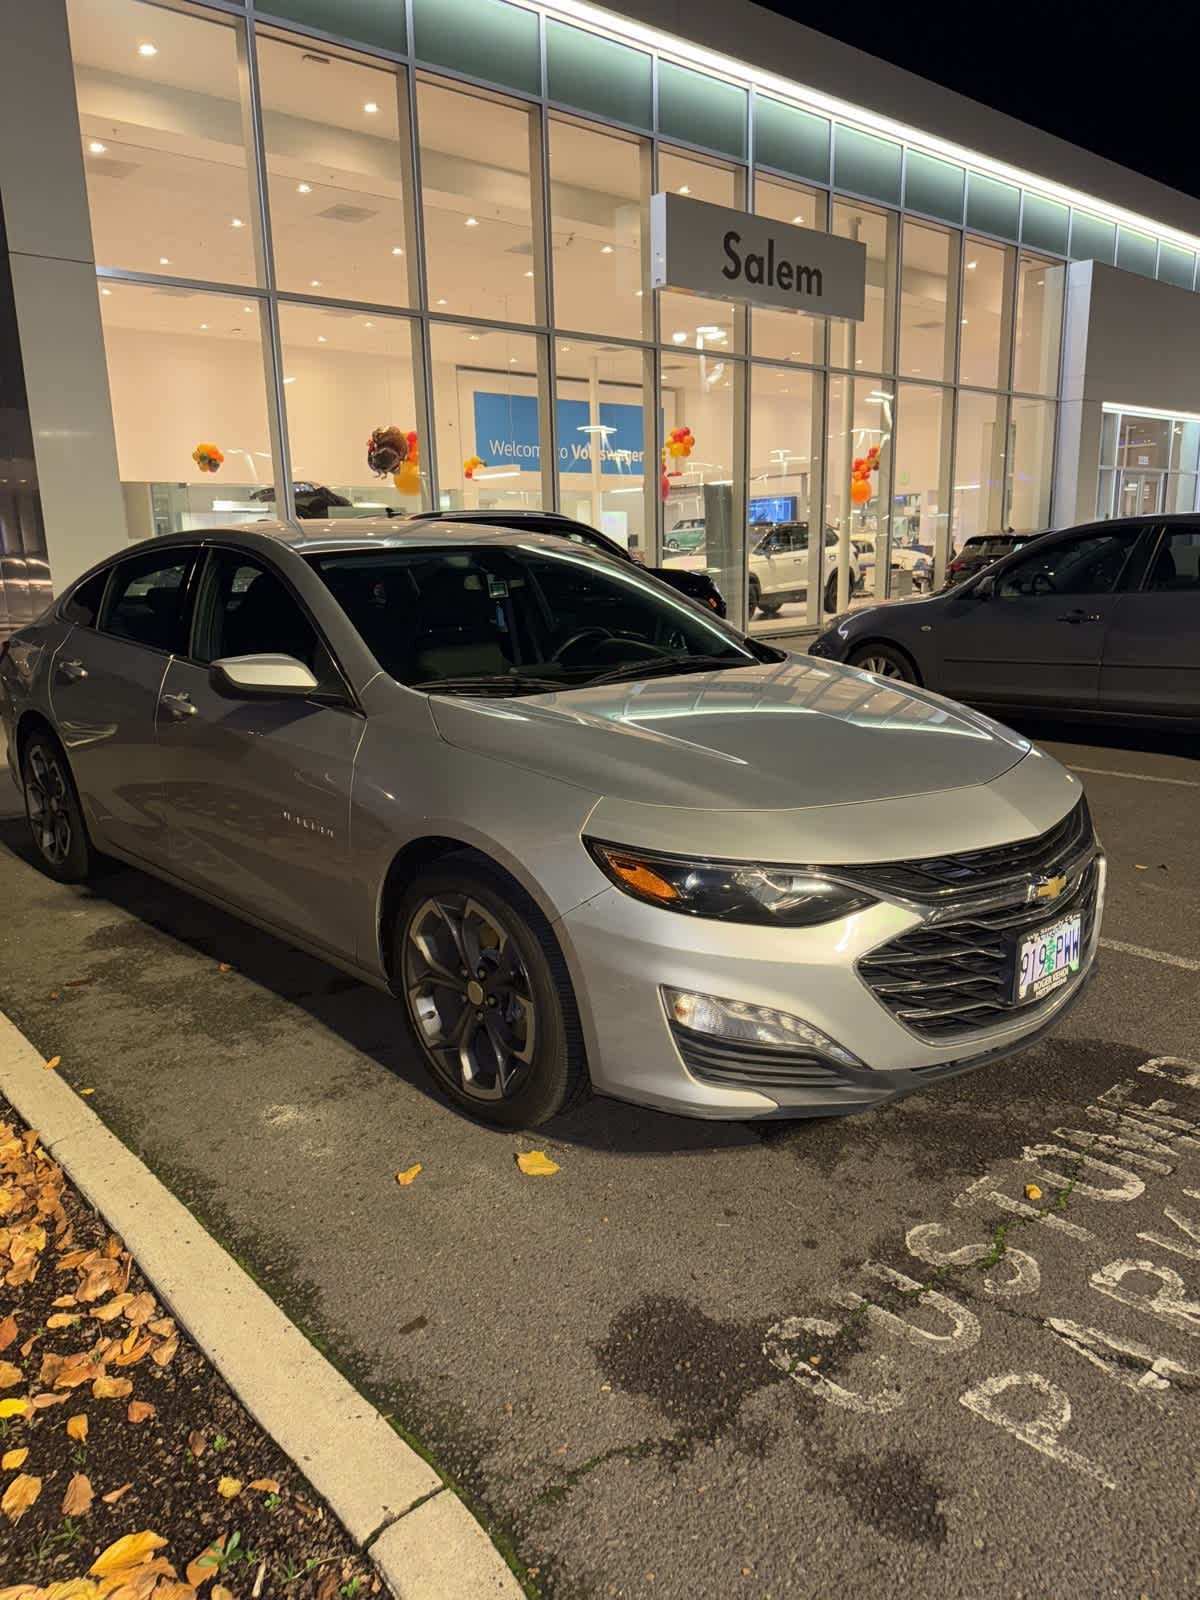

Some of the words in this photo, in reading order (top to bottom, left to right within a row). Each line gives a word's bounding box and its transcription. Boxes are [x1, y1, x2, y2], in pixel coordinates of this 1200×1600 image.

[722, 231, 823, 297] Salem
[489, 439, 541, 457] Welcom
[1020, 944, 1047, 986] 919
[1055, 926, 1080, 969] PWW
